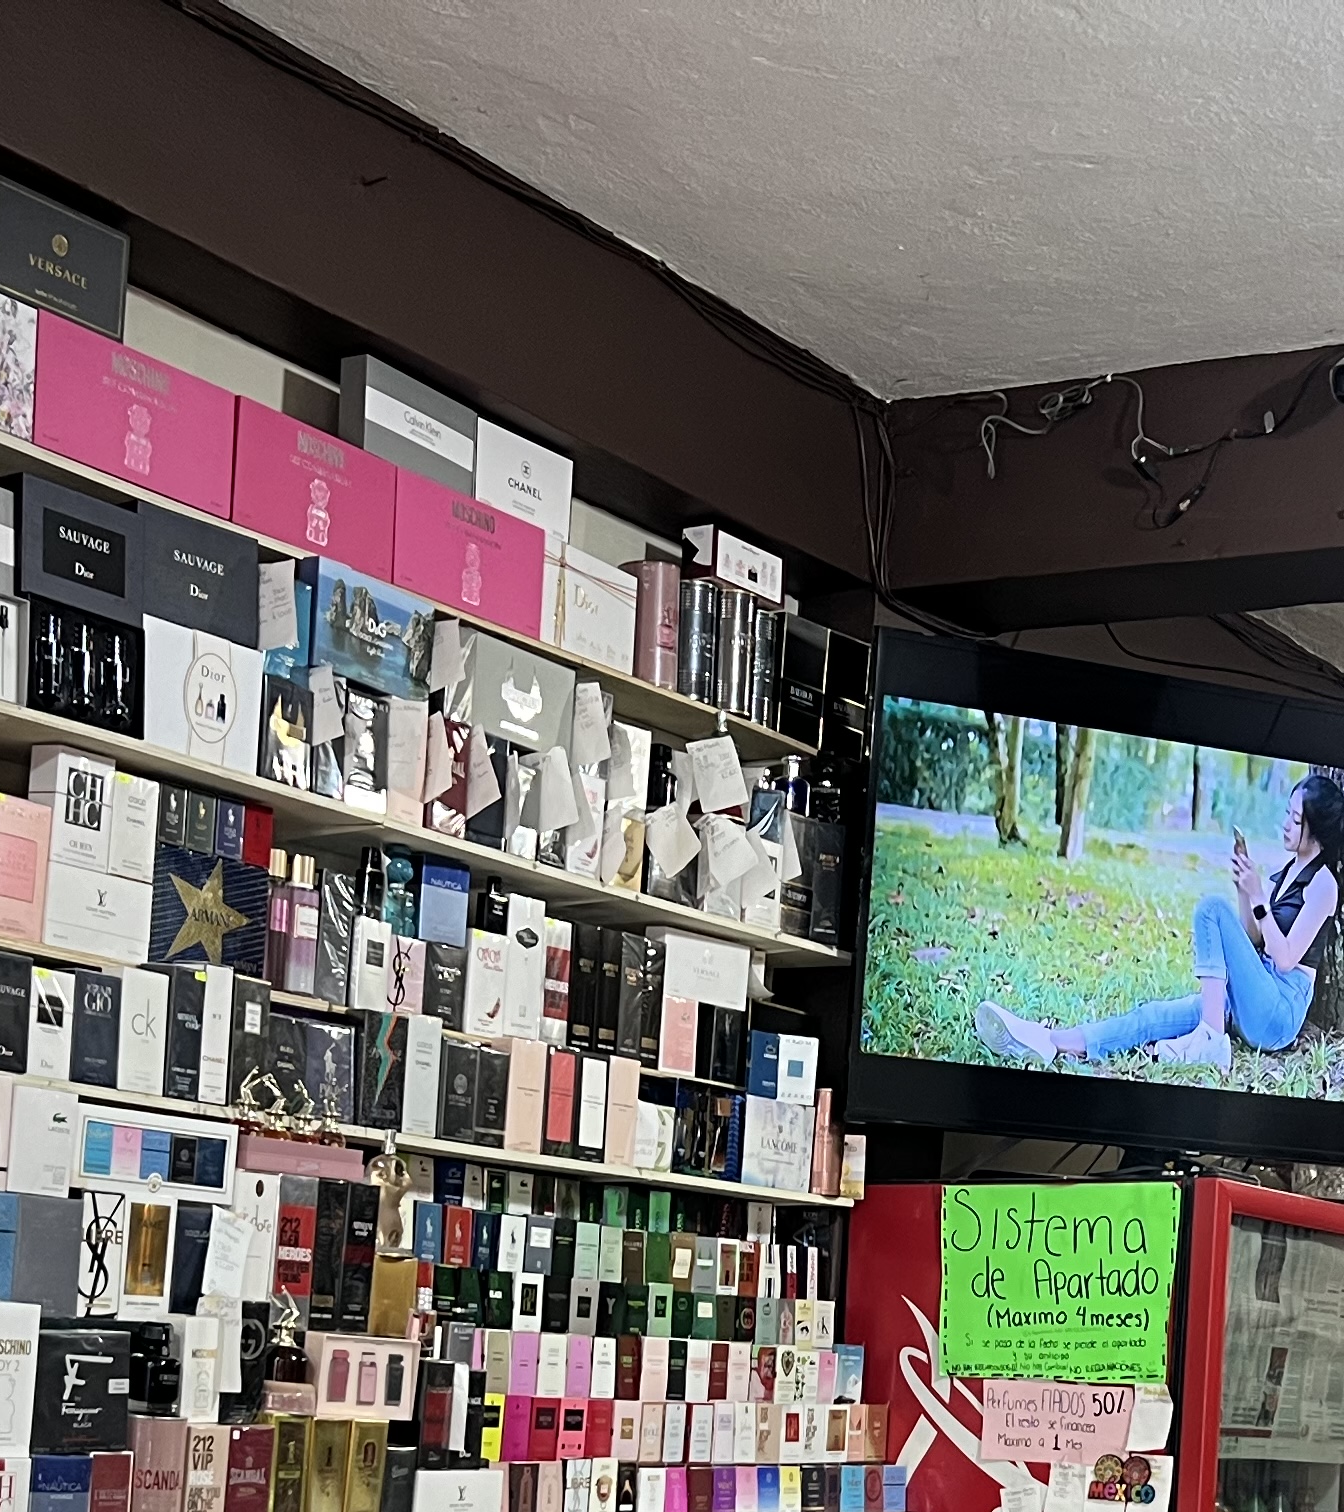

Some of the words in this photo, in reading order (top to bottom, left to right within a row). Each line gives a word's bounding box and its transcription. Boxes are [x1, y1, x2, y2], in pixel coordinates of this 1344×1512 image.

[28, 252, 89, 291] VERSACE
[507, 476, 543, 502] CHANEL
[58, 525, 111, 555] SAUVAGE
[74, 560, 95, 581] Dior
[173, 549, 225, 578] SAUVAGE
[189, 582, 210, 602] Dior
[200, 664, 228, 686] Dior
[68, 770, 104, 801] CH
[66, 799, 102, 830] HC
[430, 875, 463, 892] NAUTICA
[131, 1000, 157, 1039] ck
[760, 1137, 798, 1156] LANCÔME
[280, 1217, 302, 1233] 212
[951, 1188, 1148, 1257] Sistema
[278, 1247, 311, 1262] HEROES
[971, 1255, 1007, 1300] de
[1033, 1257, 1159, 1305] Apartado
[987, 1303, 1069, 1329] (Maximo
[982, 1340, 991, 1349] se
[1015, 1338, 1025, 1349] de
[1028, 1338, 1036, 1349] la
[1062, 1340, 1072, 1350] se
[1024, 1352, 1034, 1361] su
[1069, 1365, 1082, 1375] NO
[986, 1387, 1038, 1412] Perfumes
[1040, 1388, 1086, 1418] FIADOS
[1092, 1389, 1128, 1417] 50%
[1048, 1419, 1058, 1431] se
[193, 1435, 215, 1454] 212
[1052, 1434, 1062, 1450] 1
[1065, 1438, 1083, 1450] Mes
[192, 1453, 214, 1470] VIP
[38, 1479, 83, 1492] NAUTICA
[229, 1467, 267, 1485] SCANDAL
[188, 1487, 206, 1500] ARE
[206, 1487, 221, 1500] YOU
